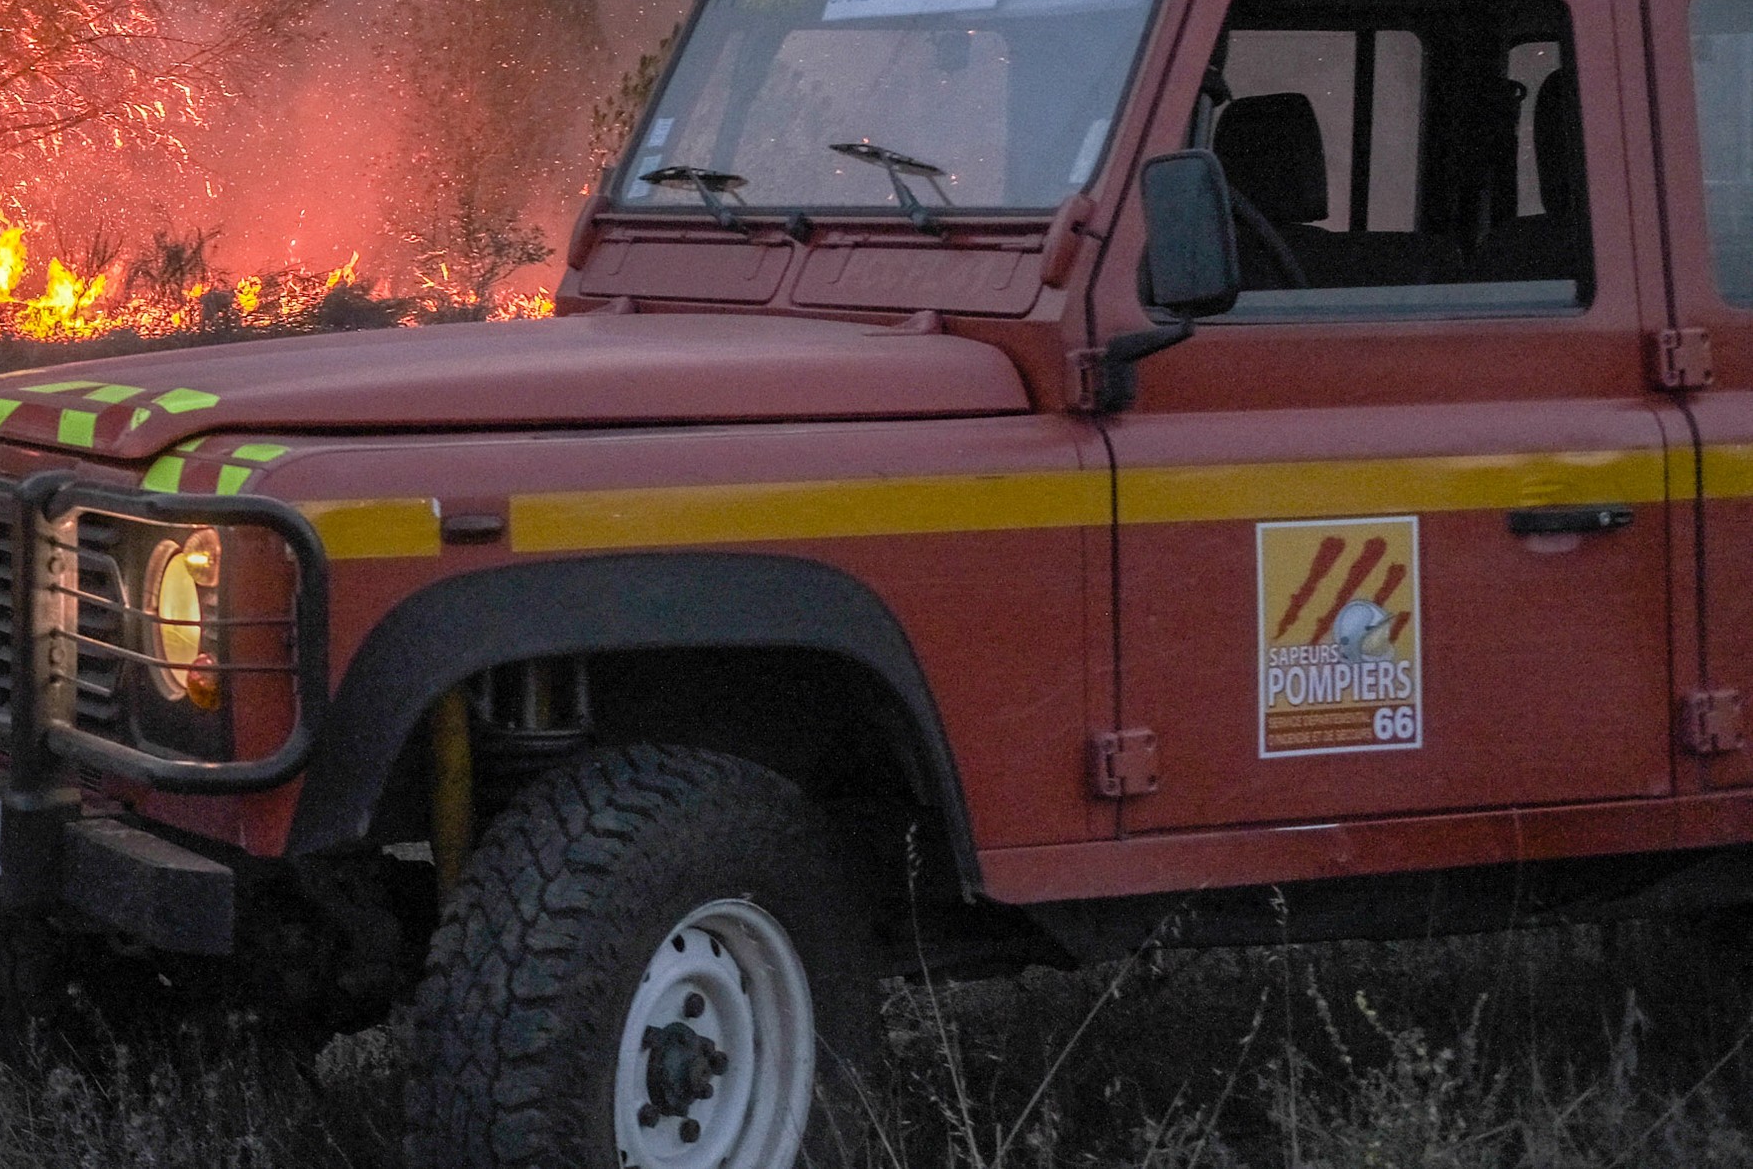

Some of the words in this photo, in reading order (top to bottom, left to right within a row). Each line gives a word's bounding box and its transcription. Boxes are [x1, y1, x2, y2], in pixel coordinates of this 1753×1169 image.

[1269, 644, 1340, 667] SAPEURS
[1268, 660, 1412, 707] POMPIERS
[1374, 707, 1414, 740] 66
